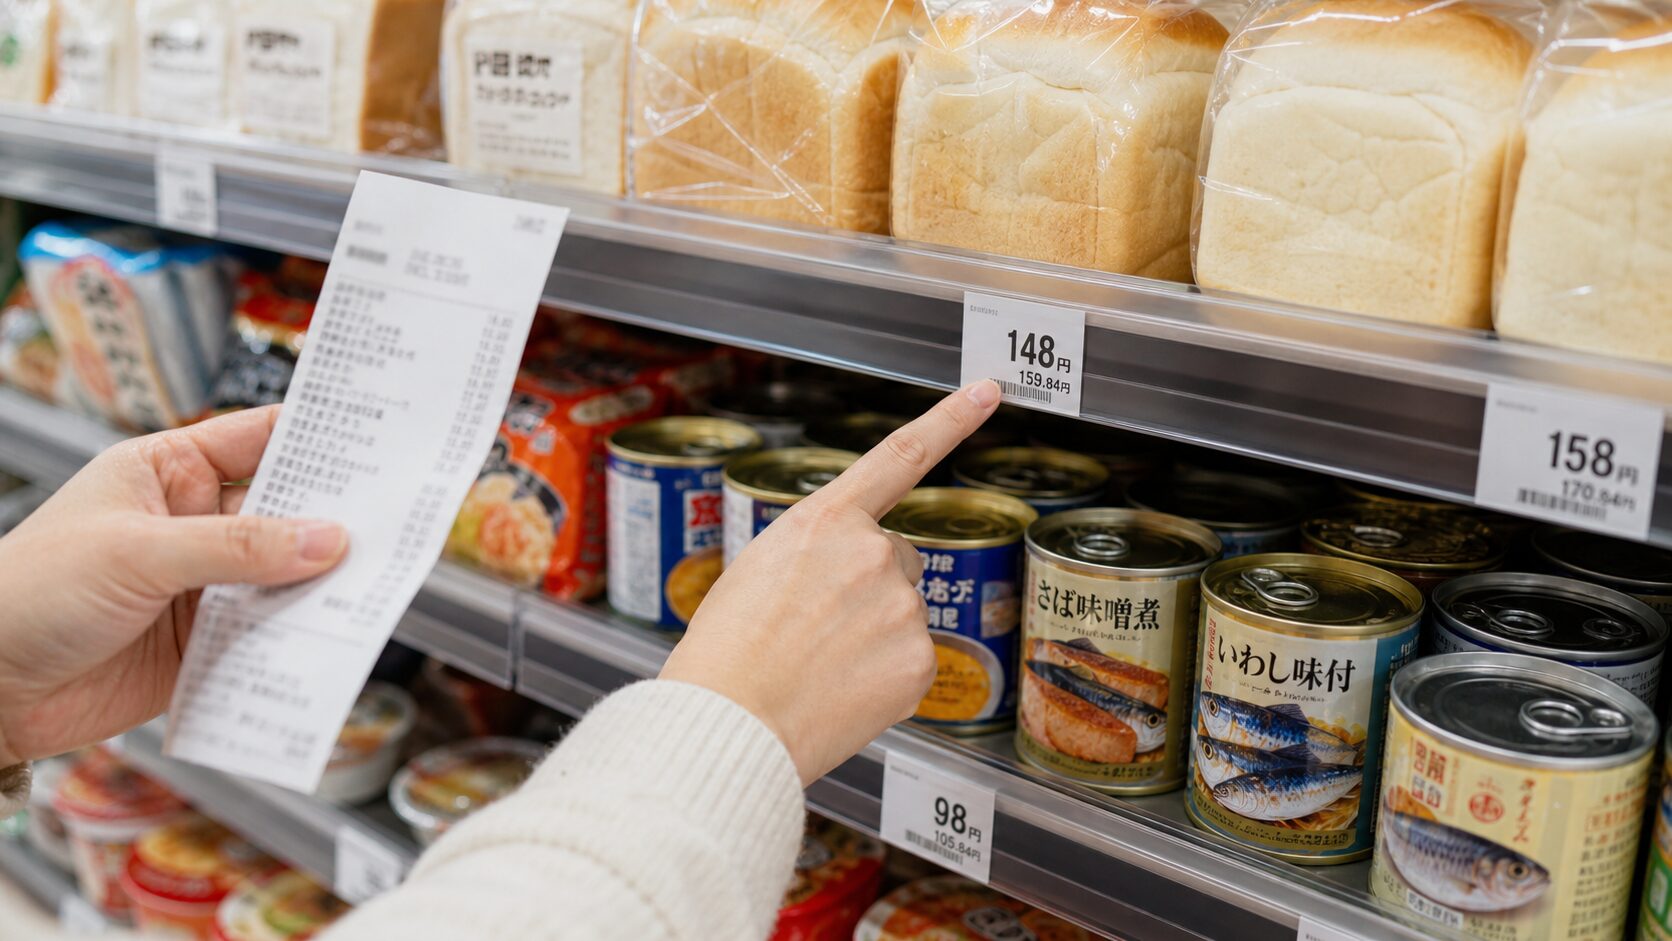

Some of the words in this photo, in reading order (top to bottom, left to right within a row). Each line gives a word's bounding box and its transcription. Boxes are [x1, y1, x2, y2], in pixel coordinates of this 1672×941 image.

[1008, 330, 1071, 373] 148円
[1019, 370, 1070, 394] 159.84円
[1548, 430, 1640, 486] 158円
[1037, 580, 1161, 630] さば味噌煮
[1218, 635, 1356, 693] いわし味付
[934, 797, 982, 843] 98円
[934, 830, 981, 862] 105.84円
